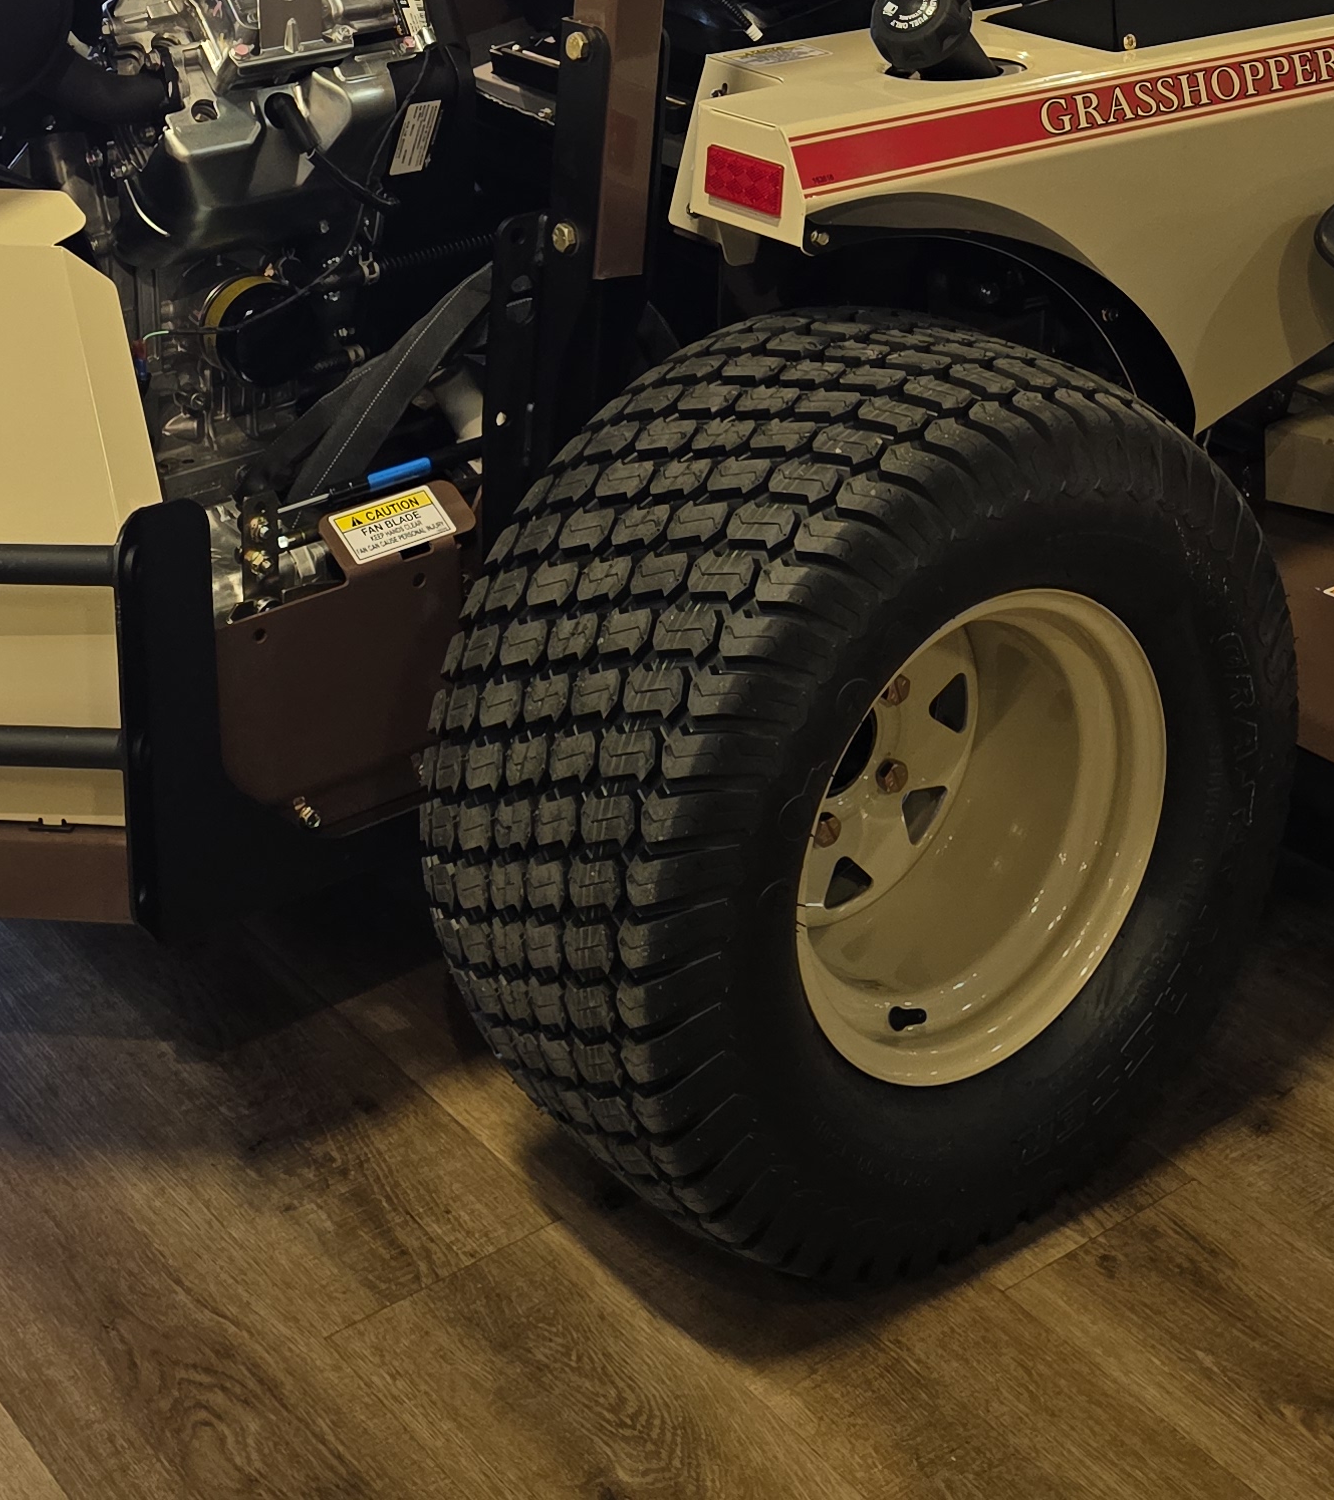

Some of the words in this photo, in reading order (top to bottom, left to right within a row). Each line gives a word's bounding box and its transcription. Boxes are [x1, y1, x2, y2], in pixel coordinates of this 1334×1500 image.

[365, 497, 420, 522] CAUTION
[361, 523, 383, 536] FAN
[384, 511, 422, 529] BLADE
[368, 542, 379, 551] CAN
[380, 537, 397, 548] CAUSE
[398, 527, 427, 543] PERSONAL
[426, 521, 444, 534] INJURY
[370, 531, 385, 542] KEEP
[386, 525, 404, 538] HANDS
[404, 520, 423, 531] CLEAR
